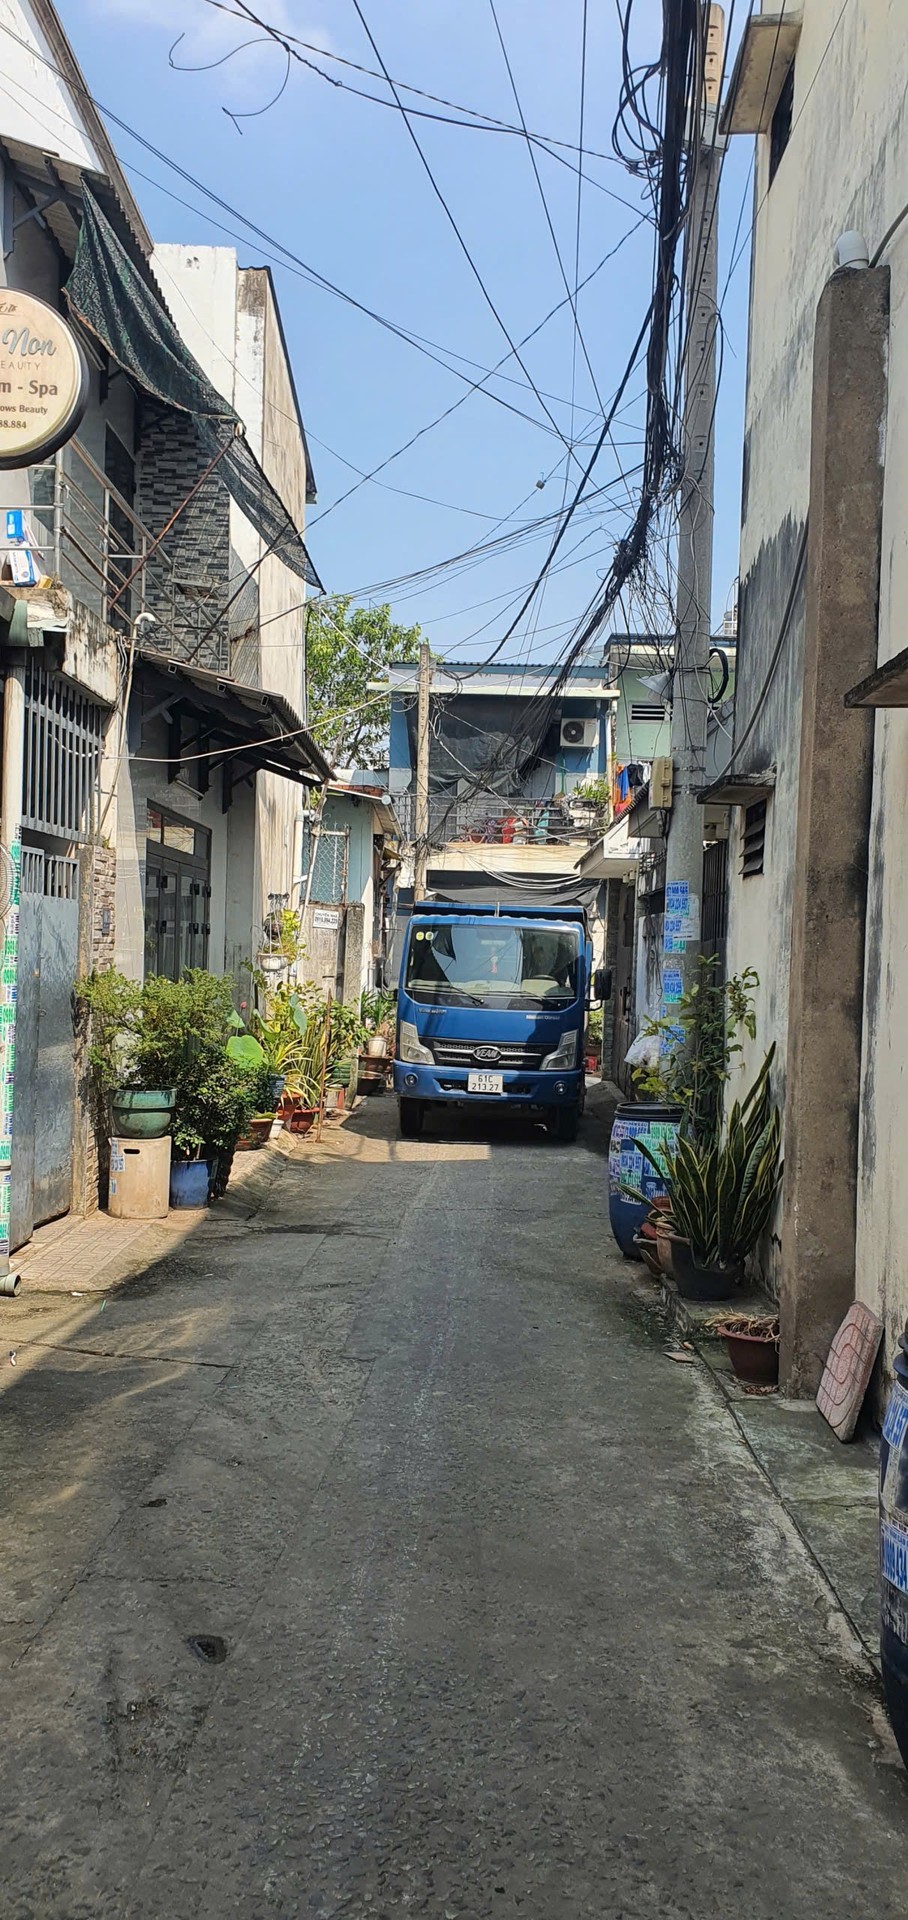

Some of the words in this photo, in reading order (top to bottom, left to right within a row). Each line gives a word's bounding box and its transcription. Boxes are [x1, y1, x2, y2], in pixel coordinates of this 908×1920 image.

[2, 327, 57, 357] Non
[28, 380, 58, 398] Spa
[19, 404, 48, 415] Beauty
[475, 1049, 499, 1059] VEAM
[478, 1074, 494, 1083] 61C
[471, 1083, 499, 1092] 213.27
